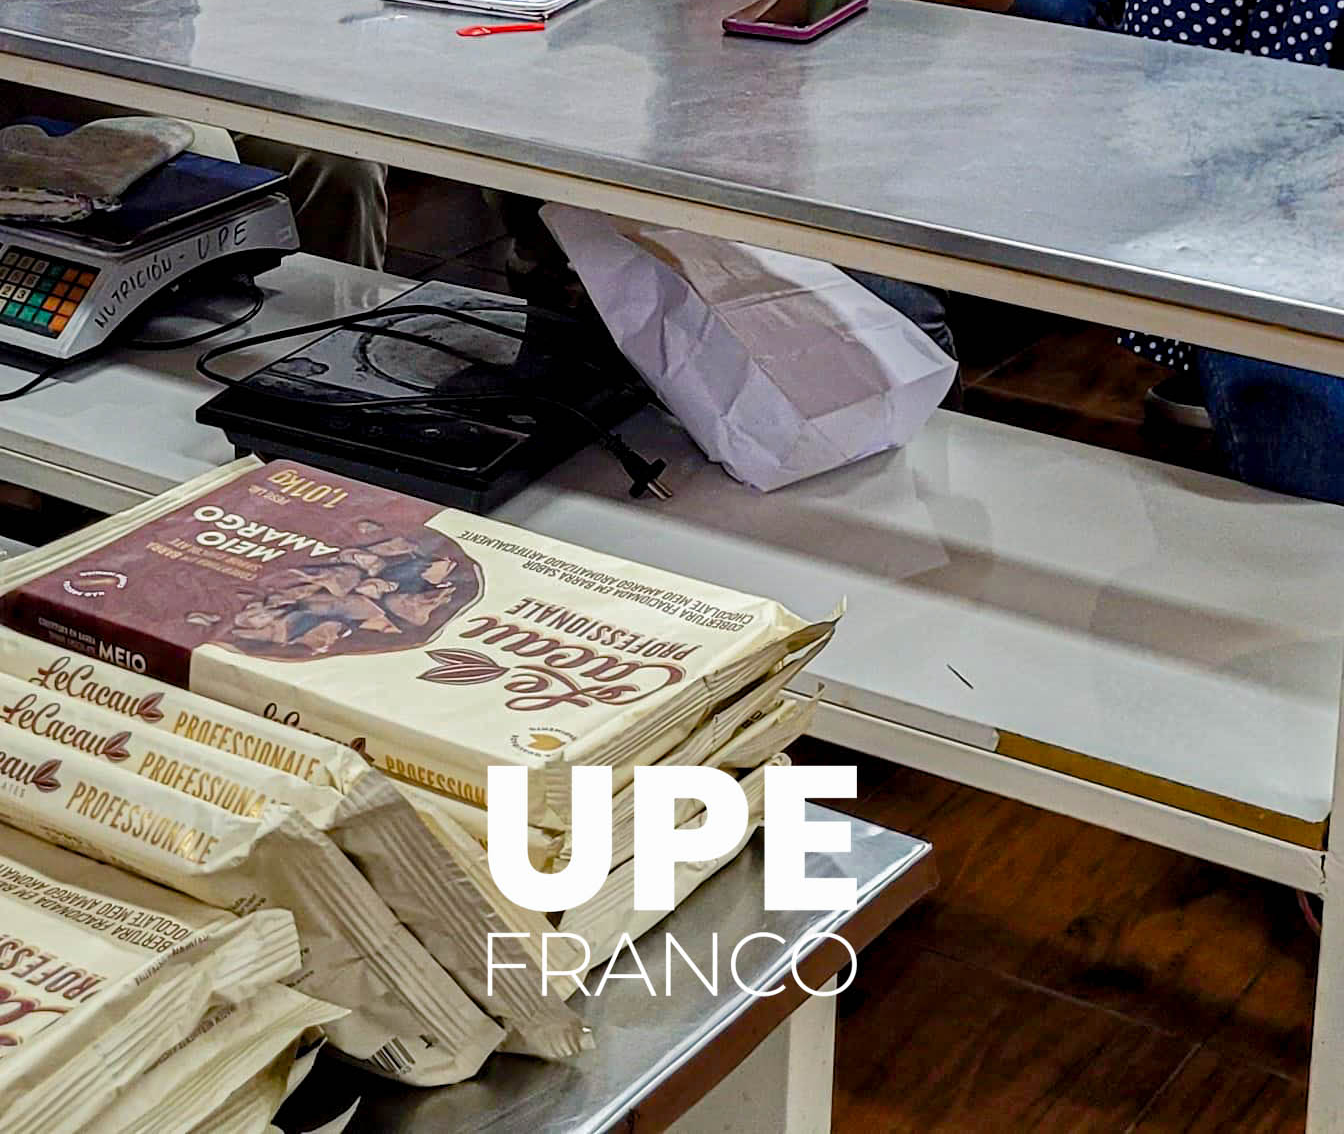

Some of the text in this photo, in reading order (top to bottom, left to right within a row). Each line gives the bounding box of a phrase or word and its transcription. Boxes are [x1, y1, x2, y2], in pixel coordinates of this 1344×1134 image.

[197, 220, 248, 260] UPE
[192, 504, 340, 557] AMARGO
[195, 530, 287, 563] MEIO
[457, 530, 754, 626] CHOCOLATE MEIO AMARGO AROMATIZADO ARTIFICIALMENTE
[522, 560, 745, 633] COBERTURA FRACIONADA EM BARRA SABOR
[503, 597, 703, 661] PROFESSIONALE
[98, 640, 148, 673] MEIO
[458, 617, 687, 706] Cacau
[29, 656, 140, 718] LeCacau
[172, 710, 320, 781] PROFESSIONALE
[65, 780, 220, 865] PROFESSIONALE
[32, 896, 113, 933] FRACIONADA
[42, 885, 102, 911] AMARGO
[99, 901, 133, 923] MEIO
[111, 925, 173, 954] BERTURA
